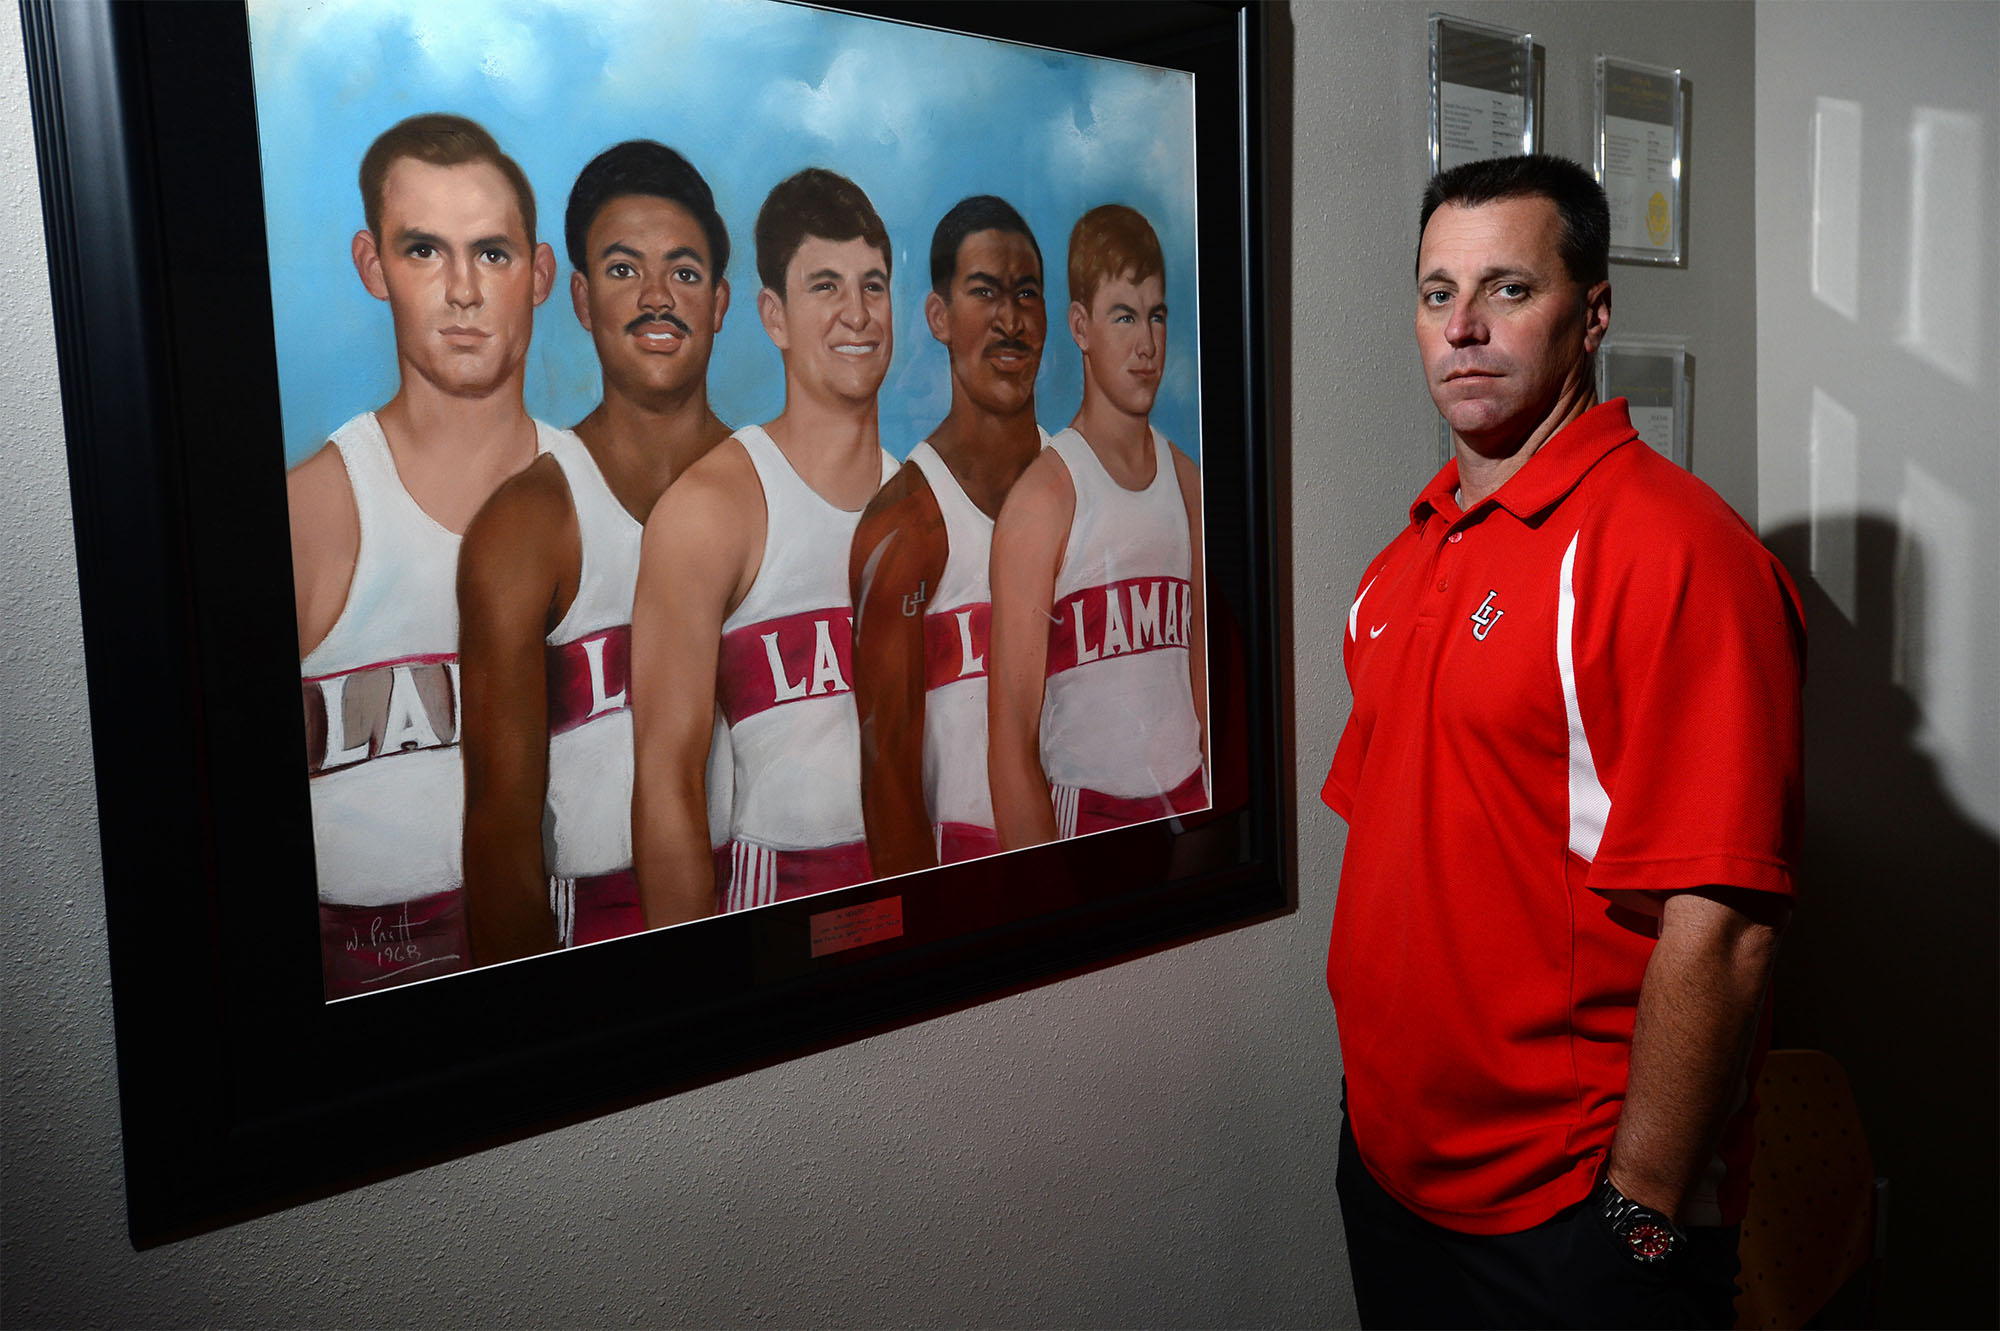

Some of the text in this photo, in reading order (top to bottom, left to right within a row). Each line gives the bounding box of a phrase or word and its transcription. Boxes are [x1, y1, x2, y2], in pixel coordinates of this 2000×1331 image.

[1469, 588, 1505, 641] LU
[760, 617, 854, 703] LA
[319, 663, 462, 770] LA
[378, 944, 422, 967] 1968
